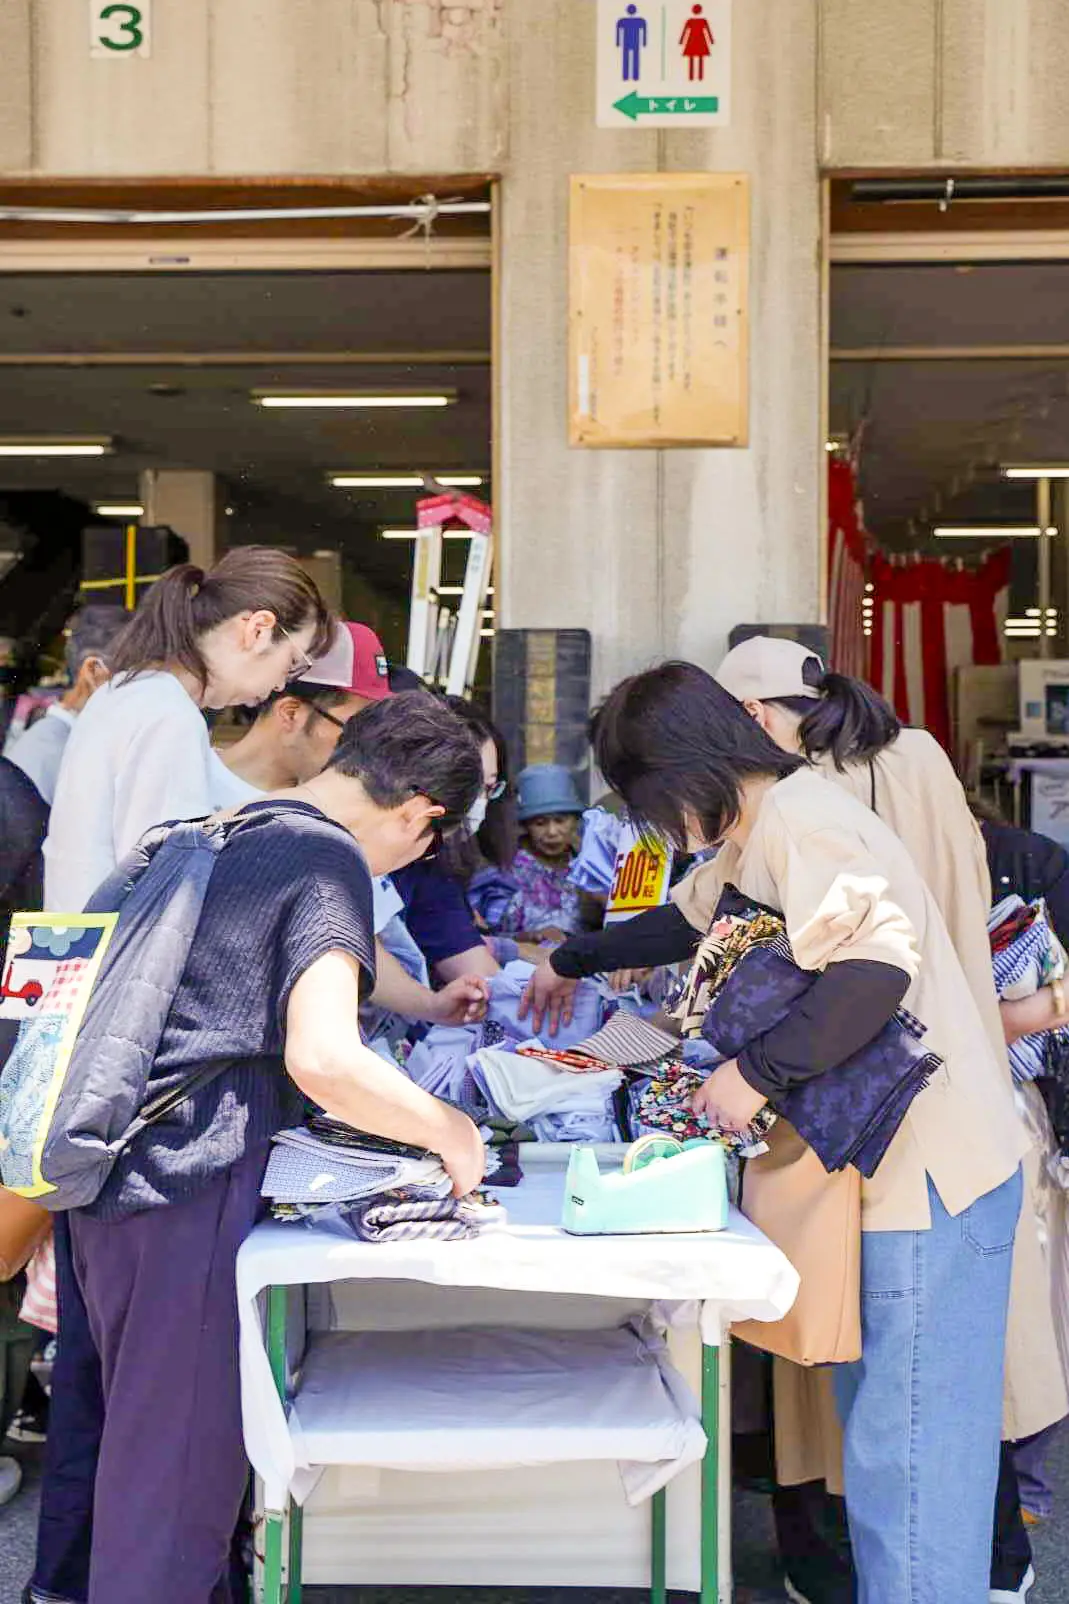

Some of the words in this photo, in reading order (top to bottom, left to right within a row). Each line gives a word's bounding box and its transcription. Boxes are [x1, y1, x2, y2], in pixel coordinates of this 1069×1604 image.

[99, 4, 143, 50] 3
[648, 99, 696, 111] トイレ
